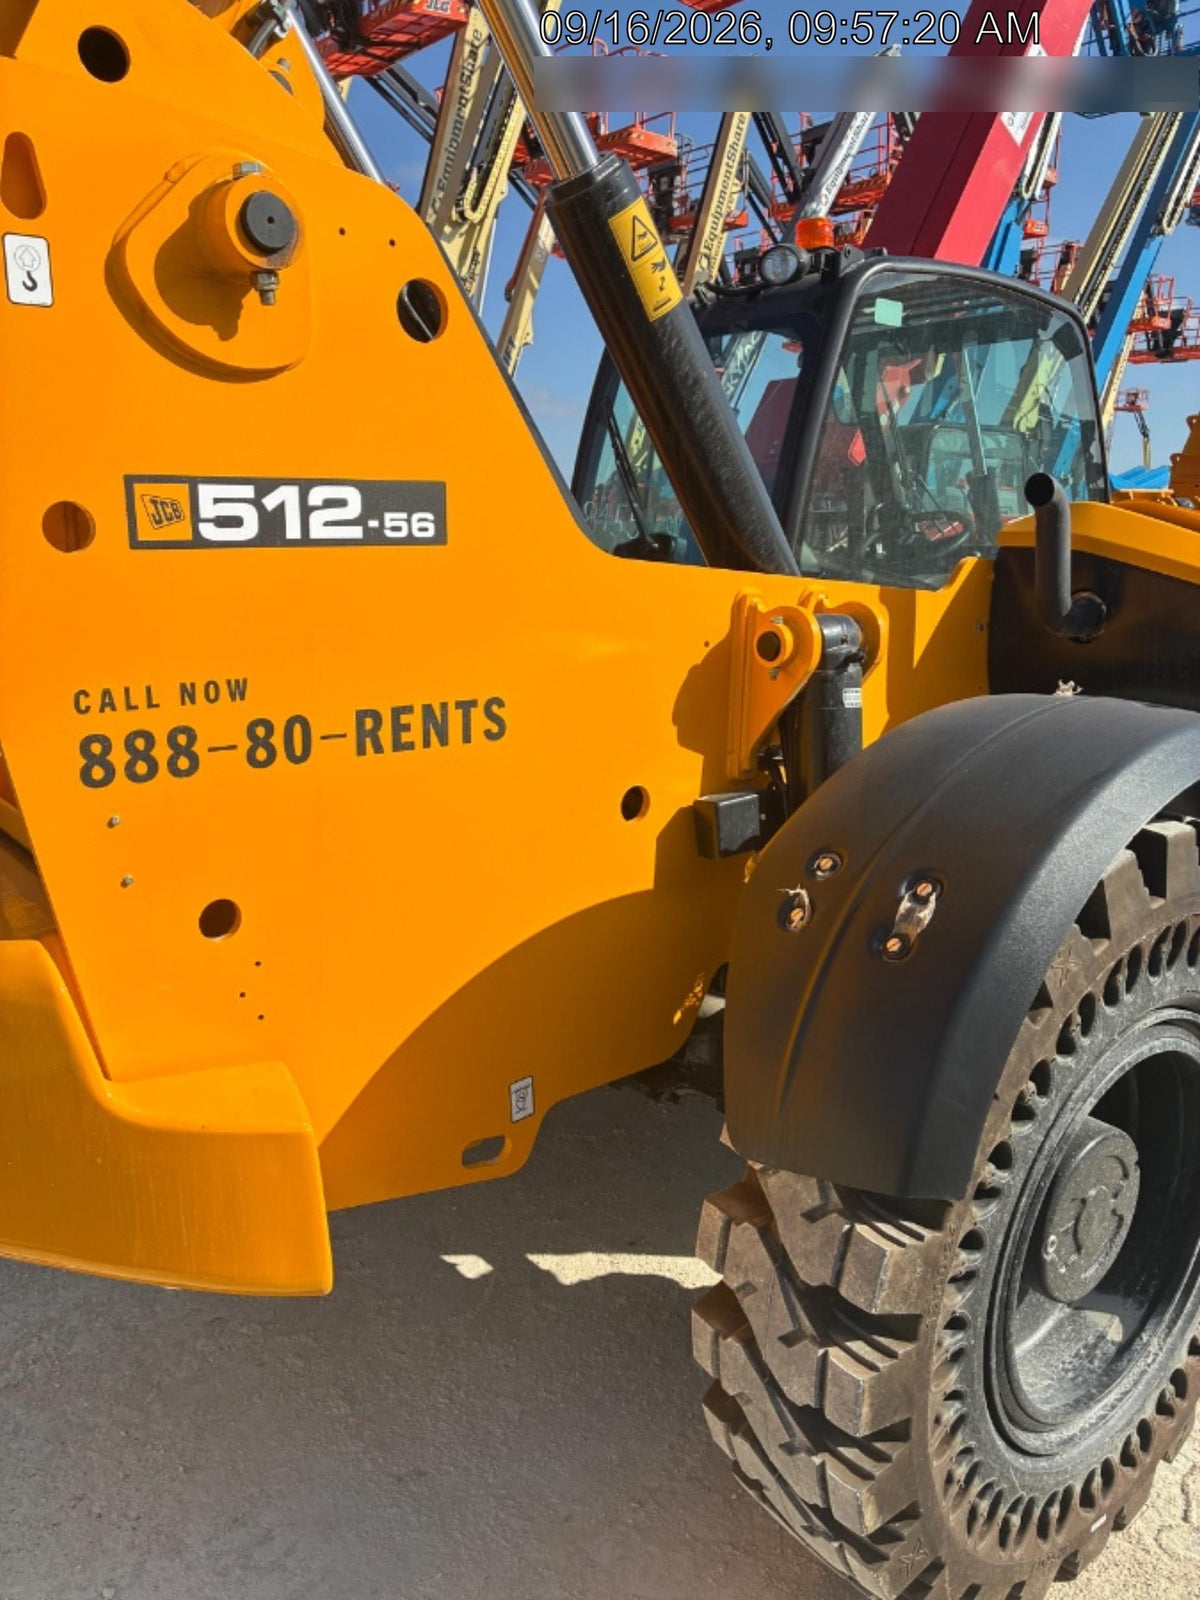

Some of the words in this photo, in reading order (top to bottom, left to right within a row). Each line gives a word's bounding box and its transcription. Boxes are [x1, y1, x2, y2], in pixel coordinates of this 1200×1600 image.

[703, 112, 748, 251] EquipmentShare
[147, 496, 183, 527] JCB
[197, 484, 437, 542] 512-56
[73, 685, 161, 715] CALL
[179, 677, 249, 706] NOW
[78, 696, 508, 789] 888-80-RENTS
